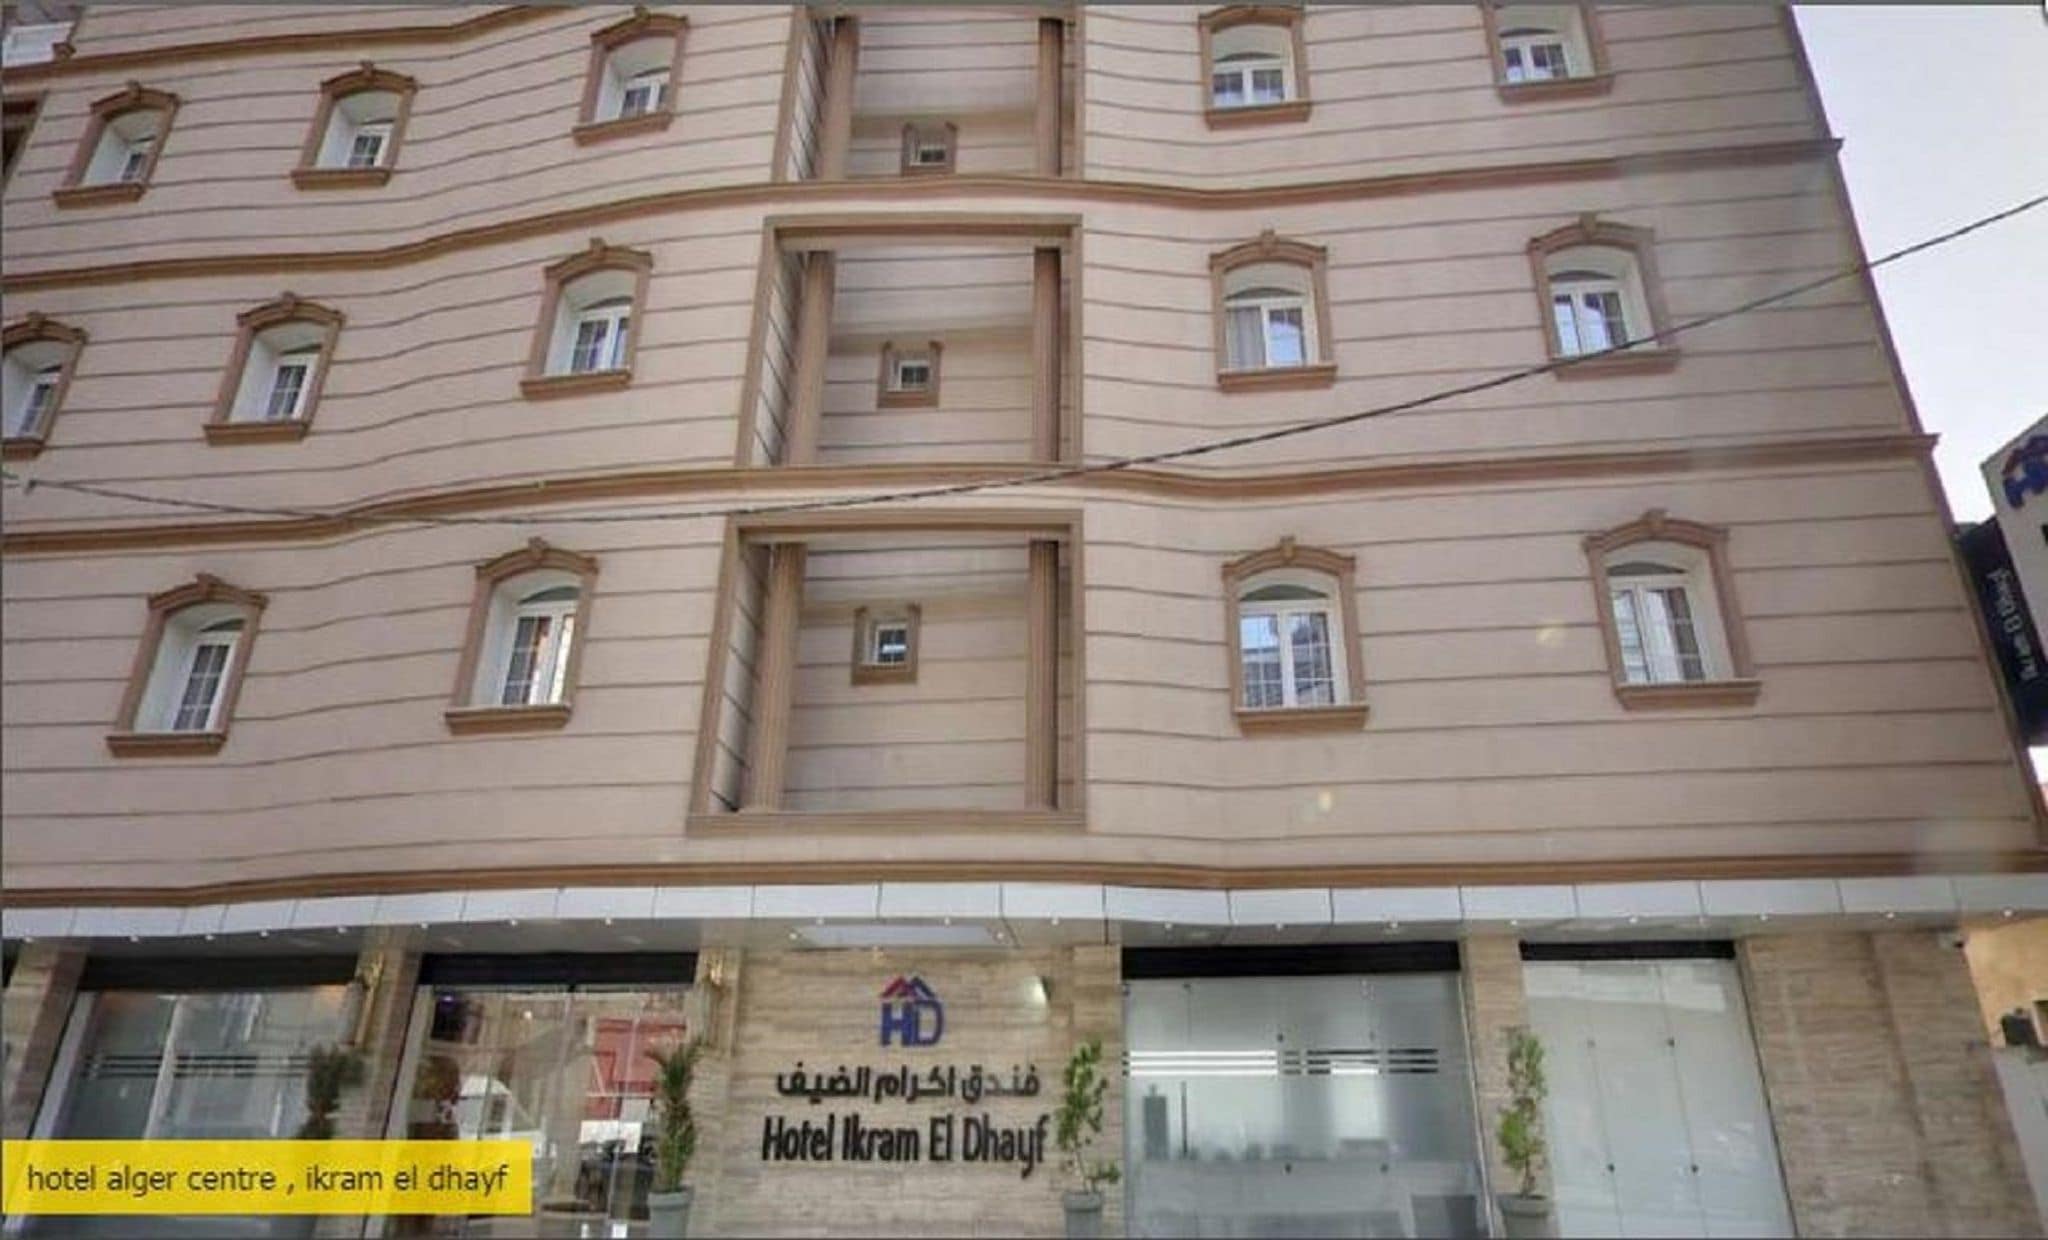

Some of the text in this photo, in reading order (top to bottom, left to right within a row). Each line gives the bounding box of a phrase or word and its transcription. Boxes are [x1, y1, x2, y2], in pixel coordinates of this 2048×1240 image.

[776, 1061, 1040, 1104] فندق اكرام الضيف
[762, 1114, 1049, 1179] Hotel Ikram El Dhayf
